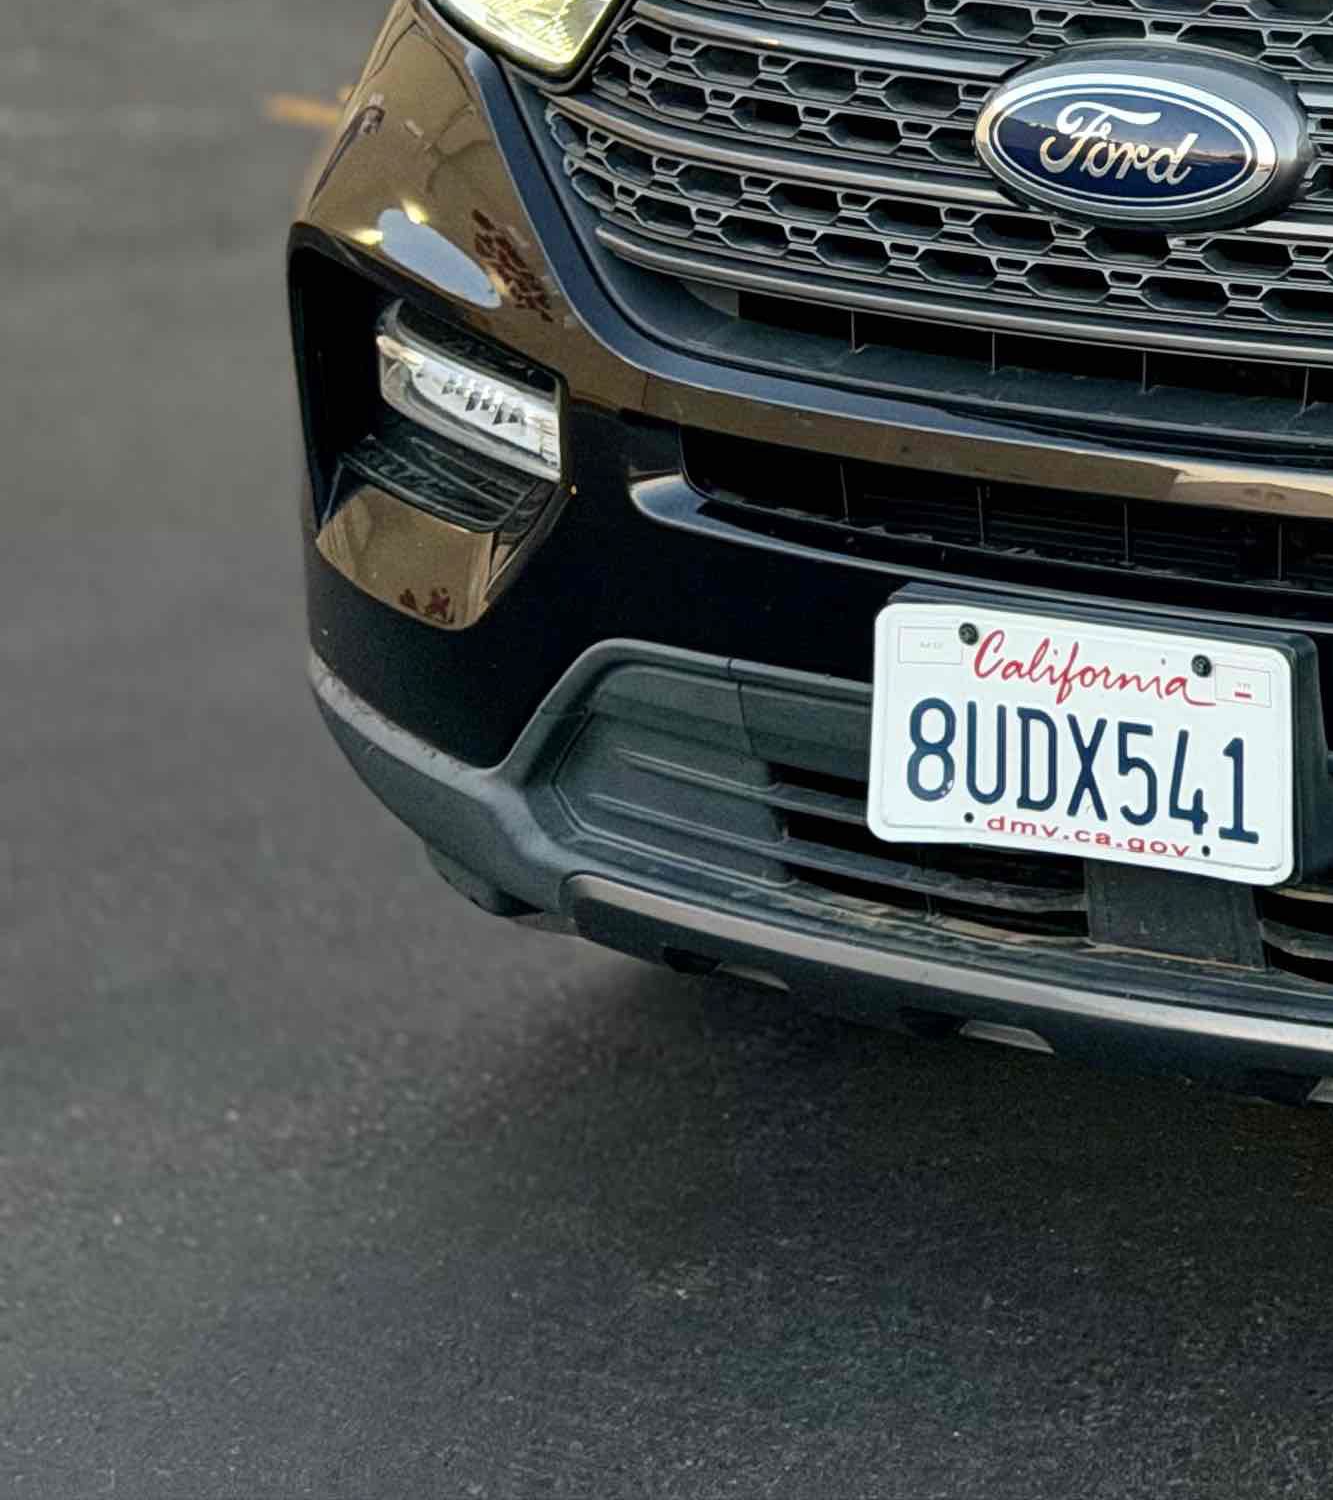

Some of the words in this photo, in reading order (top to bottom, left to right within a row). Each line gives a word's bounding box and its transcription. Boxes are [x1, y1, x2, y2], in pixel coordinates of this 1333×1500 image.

[1038, 100, 1200, 185] Ford
[973, 629, 1217, 707] California
[905, 696, 1260, 845] 8UDX541
[985, 814, 1192, 858] dmv.ca.gov
